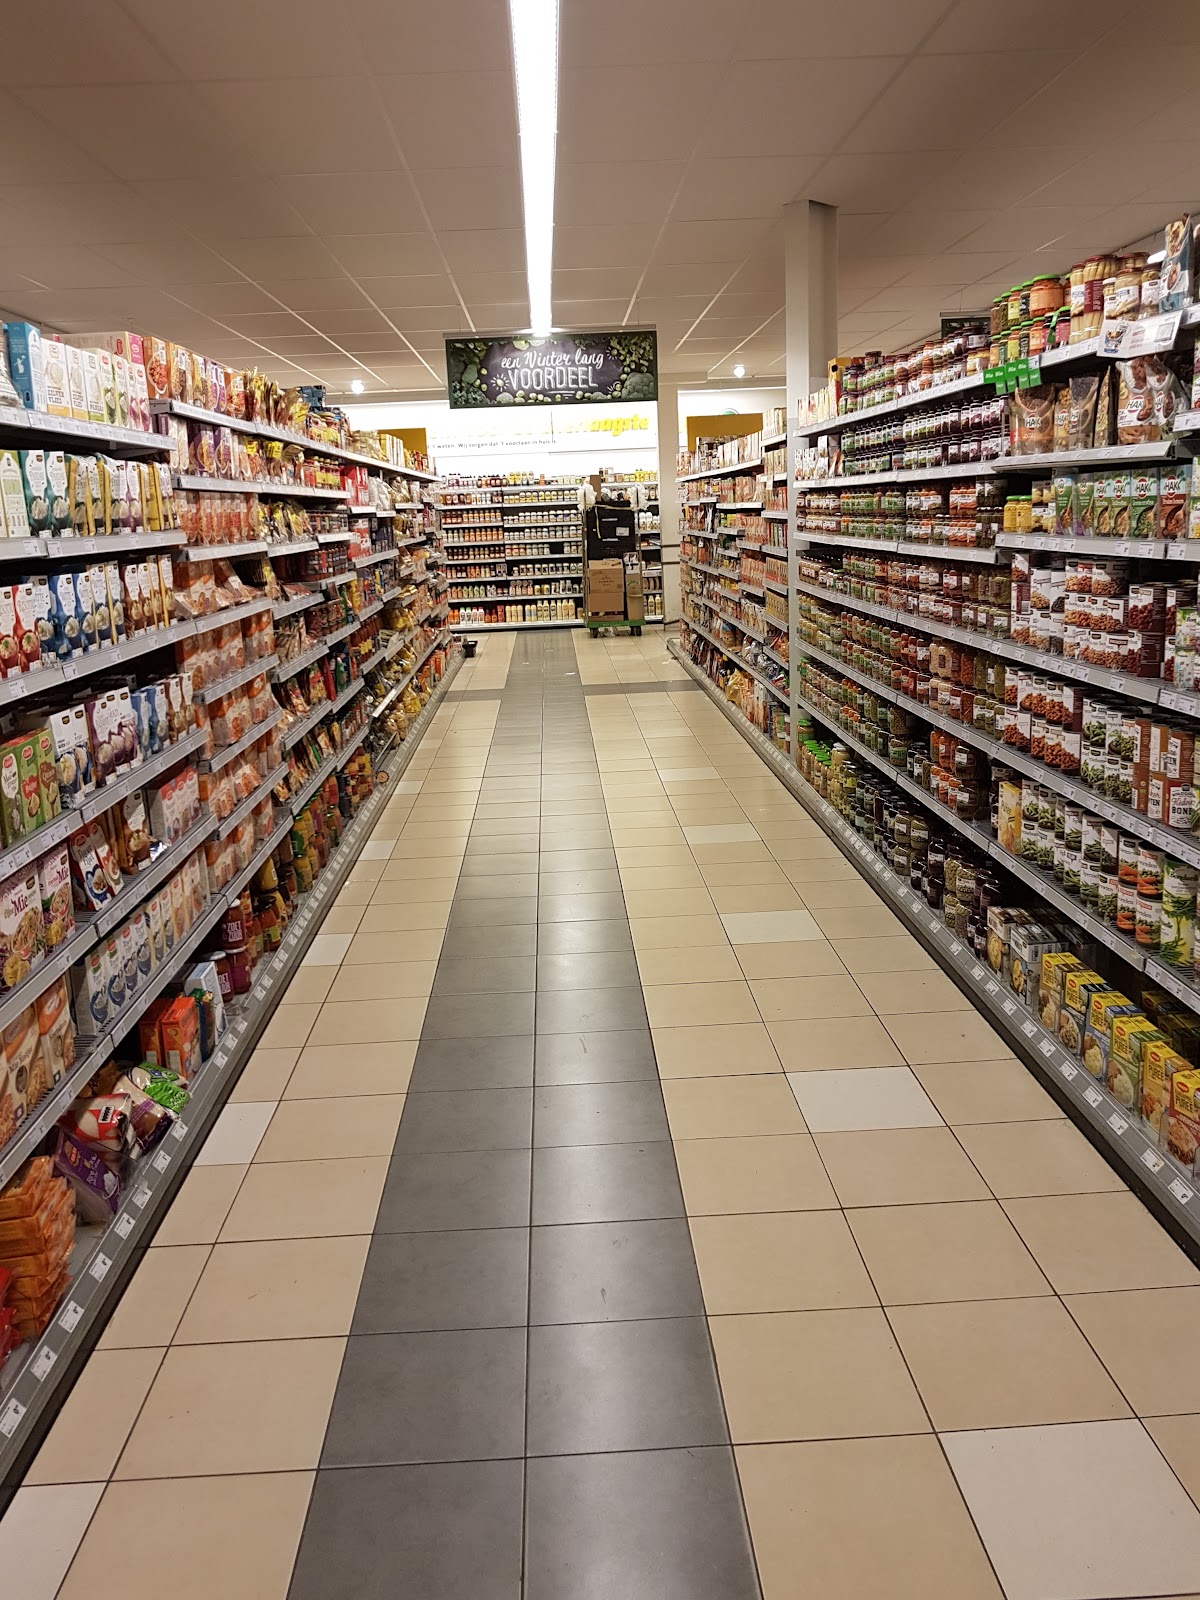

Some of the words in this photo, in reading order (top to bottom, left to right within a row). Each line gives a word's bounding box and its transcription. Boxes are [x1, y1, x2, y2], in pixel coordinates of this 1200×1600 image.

[501, 357, 520, 369] een
[523, 350, 571, 369] Winter
[574, 347, 604, 369] lang
[507, 366, 599, 390] VOORDEEL
[1135, 483, 1151, 492] HAK
[1164, 482, 1180, 492] HAK
[1172, 806, 1192, 815] BONE
[227, 920, 242, 932] ZOET
[1175, 1094, 1194, 1113] PUREE
